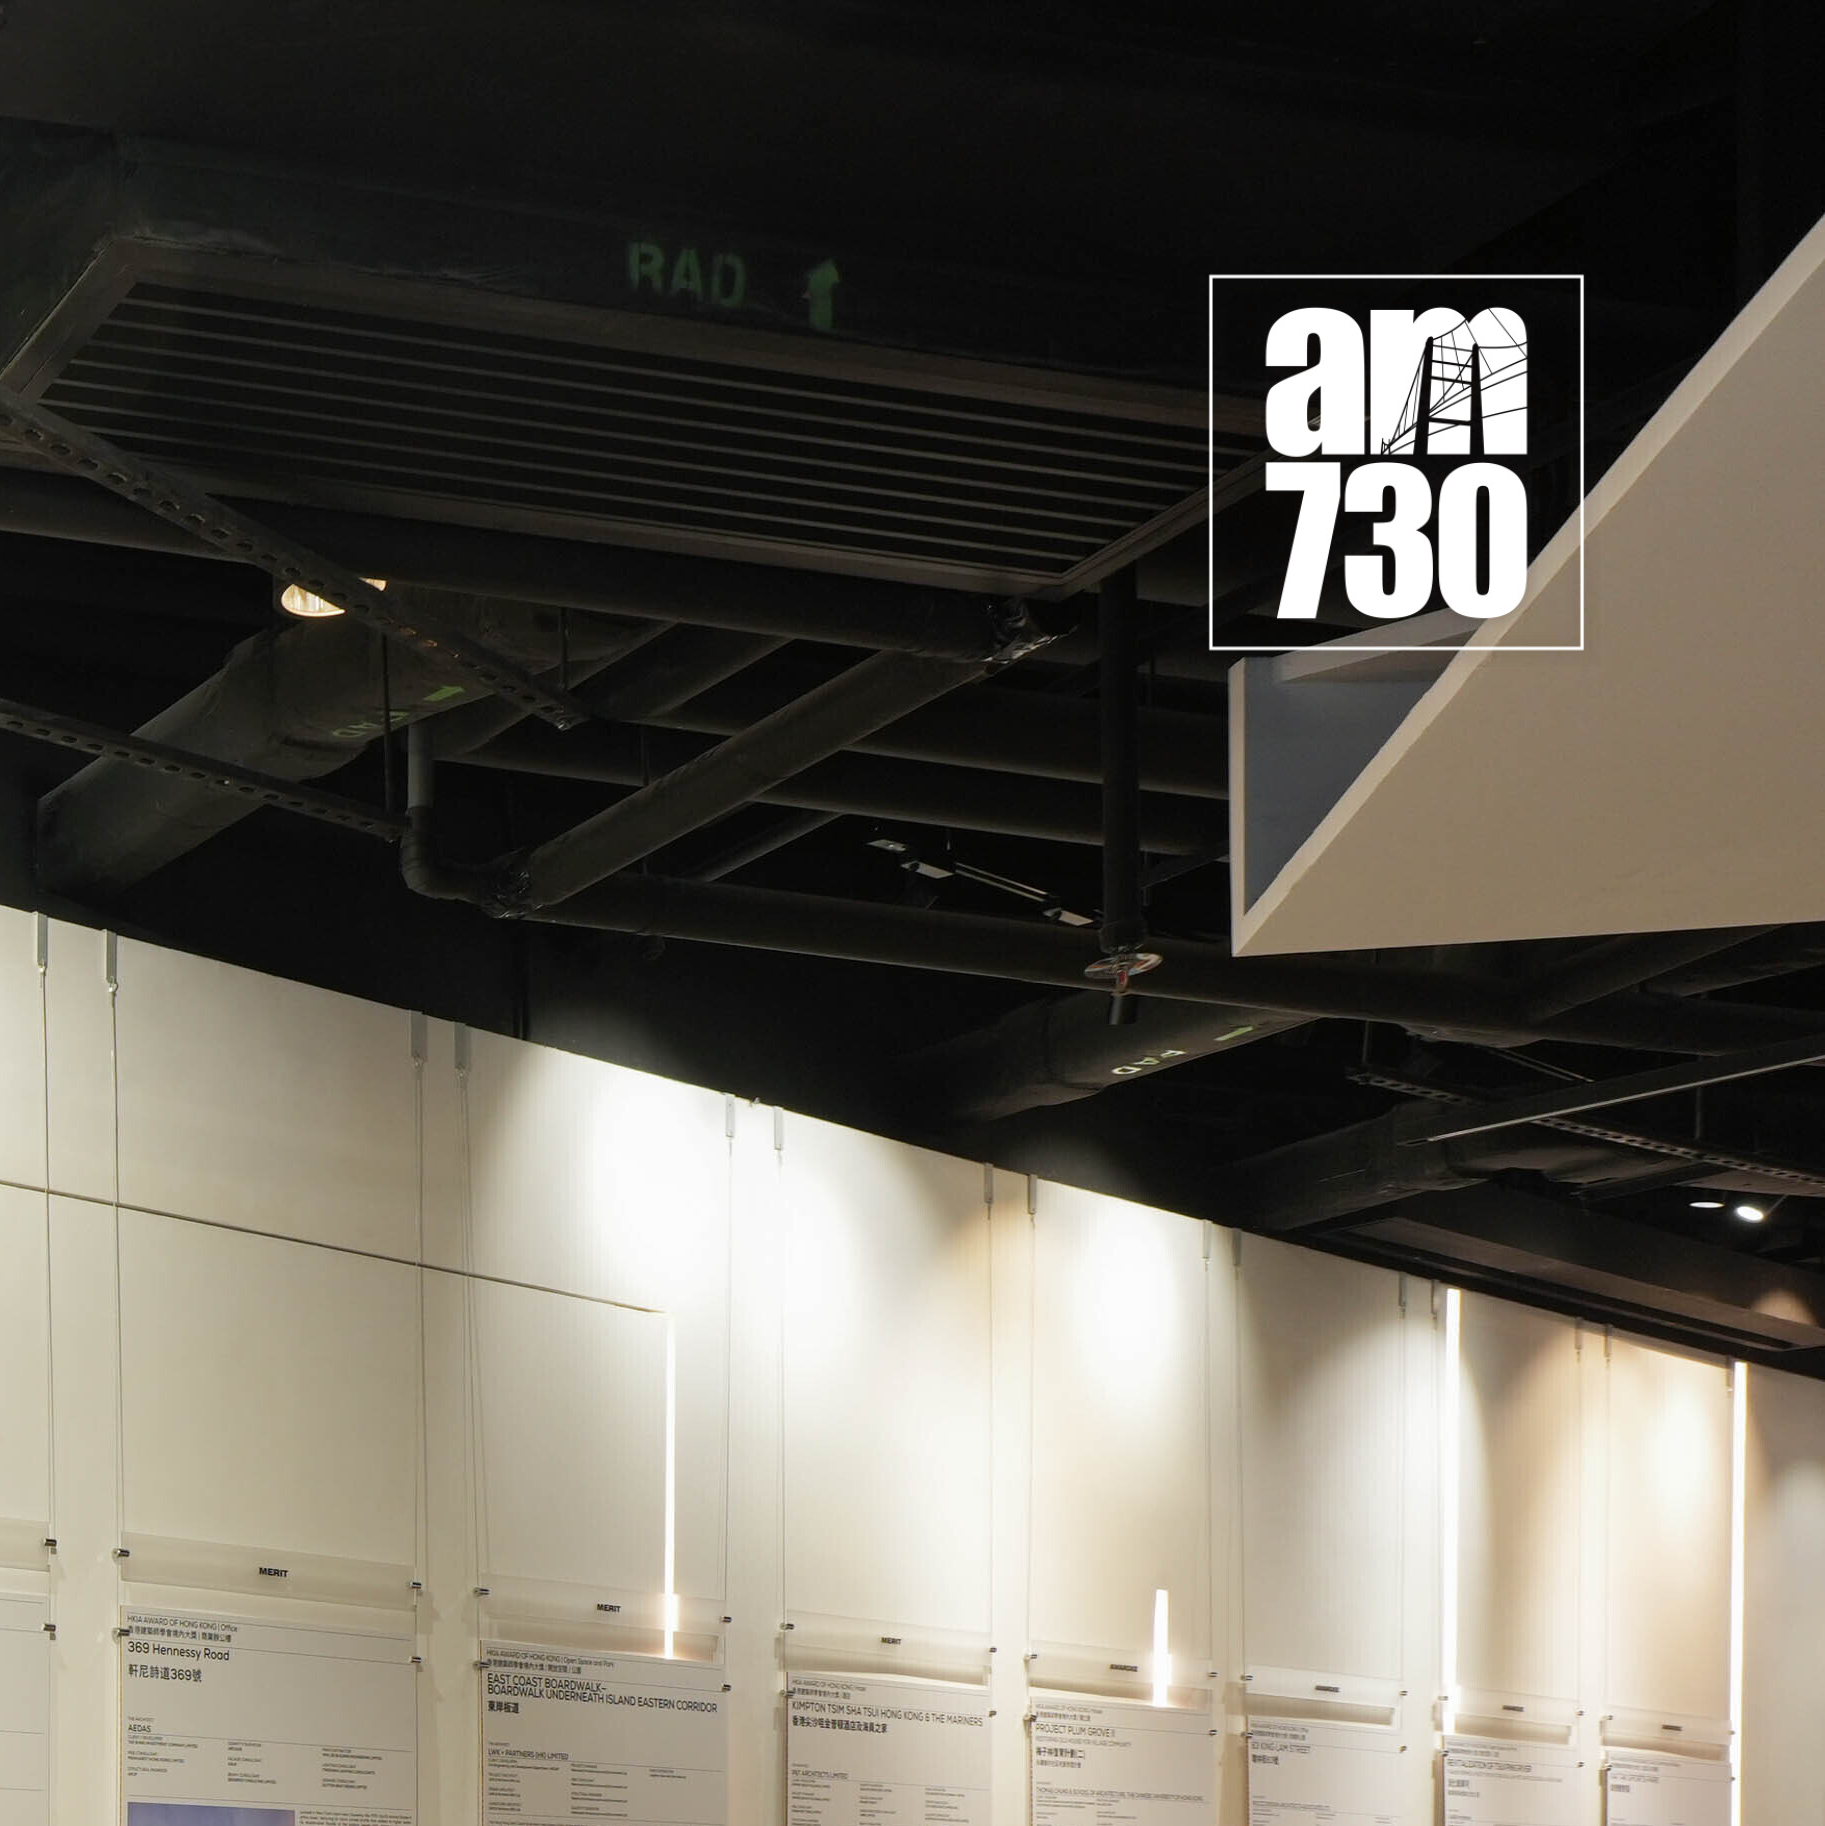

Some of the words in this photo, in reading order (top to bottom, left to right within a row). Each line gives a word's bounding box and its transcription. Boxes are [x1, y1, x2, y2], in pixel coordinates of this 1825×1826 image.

[628, 242, 745, 307] RAD
[259, 1567, 288, 1577] MERIT
[596, 1603, 621, 1612] MERIT
[143, 1616, 168, 1625] AWARD
[168, 1618, 178, 1626] OF
[179, 1619, 198, 1628] HONG
[199, 1621, 217, 1630] KONG
[220, 1623, 237, 1632] Office
[127, 1640, 149, 1653] 369
[152, 1643, 201, 1661] Hennessy
[203, 1647, 229, 1660] Road
[128, 1663, 201, 1682] 軒尼詩道369號
[487, 1672, 510, 1685] EAST
[512, 1674, 542, 1687] COAST
[487, 1684, 544, 1698] BOARDWALK
[545, 1689, 604, 1702] UNDERNEATH
[605, 1693, 635, 1706] ISLAND
[637, 1696, 674, 1708] EASTERN
[675, 1699, 717, 1712] CORRIDOR
[792, 1701, 825, 1712] KIMPTON
[827, 1703, 844, 1713] TSIM
[845, 1705, 861, 1715] SHA
[862, 1706, 879, 1717] TSUI
[880, 1708, 902, 1719] HONG
[903, 1710, 923, 1721] KONG
[931, 1712, 945, 1723] THE
[946, 1714, 982, 1727] MARINERS
[128, 1723, 151, 1732] AEDAS
